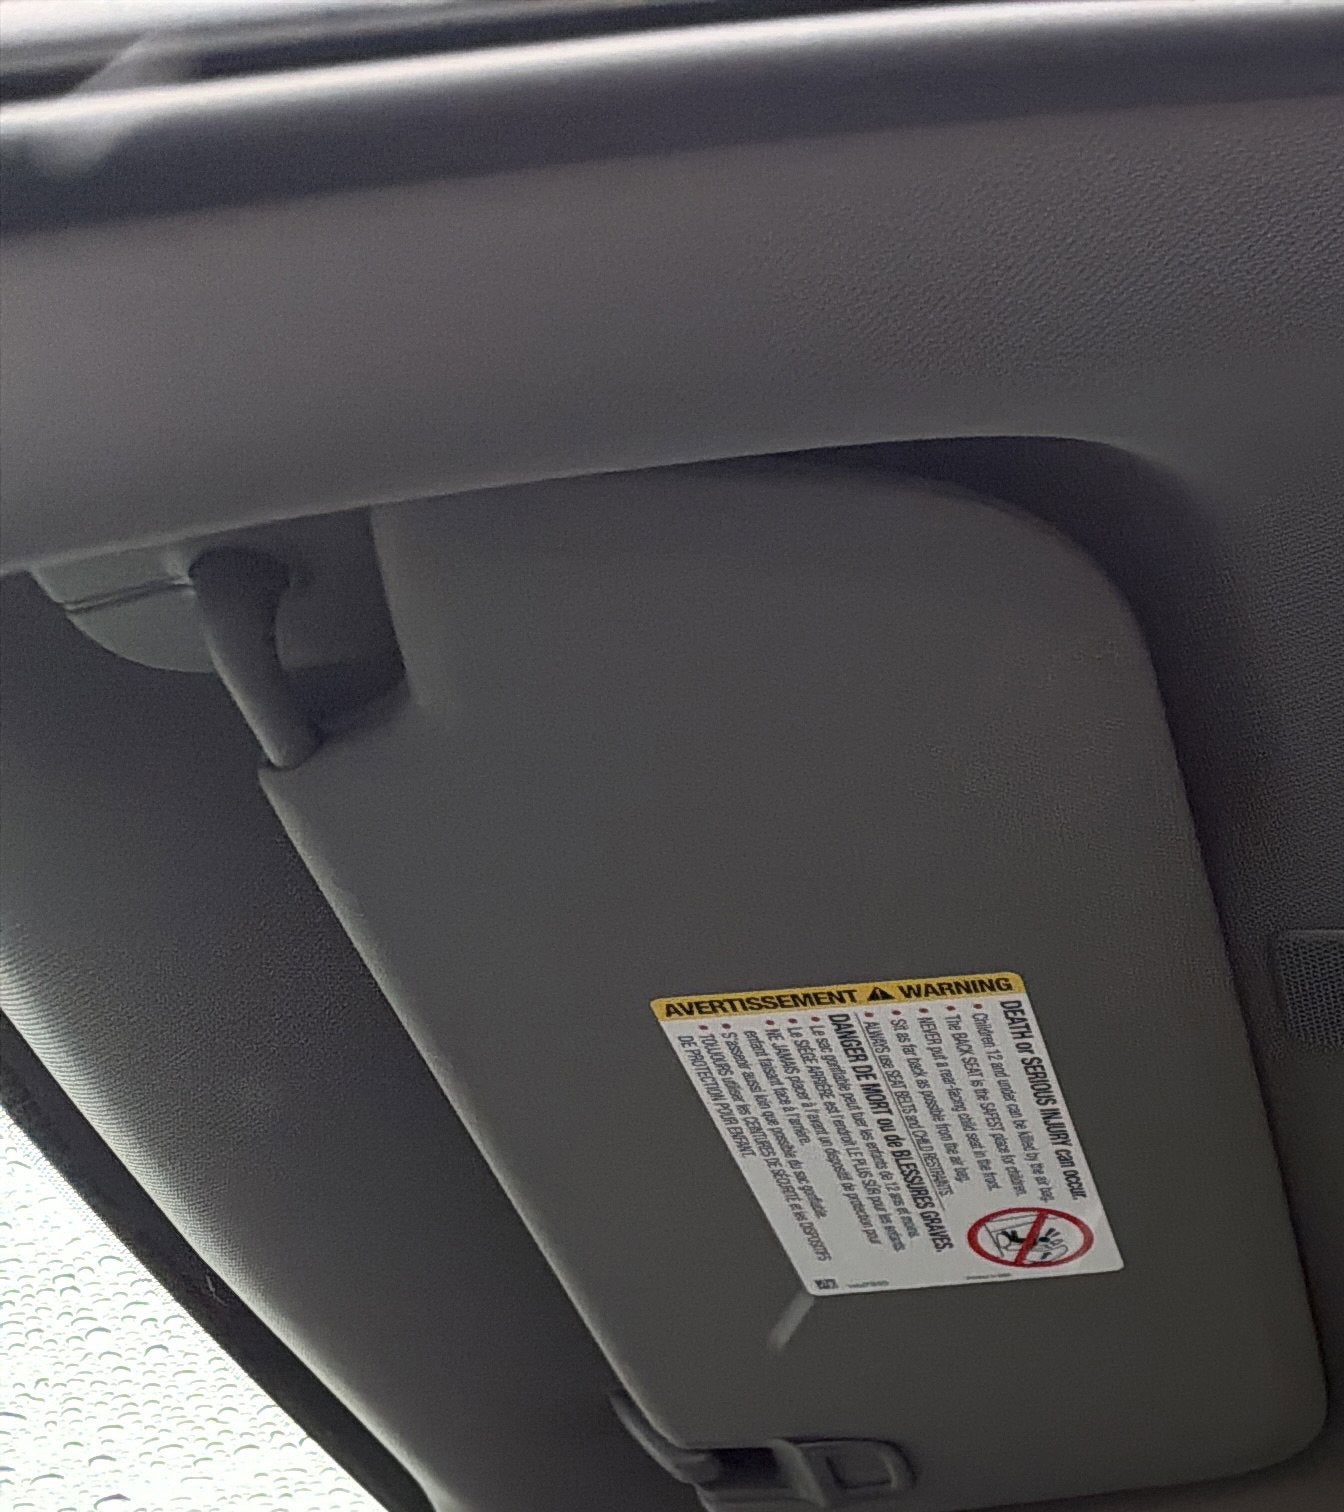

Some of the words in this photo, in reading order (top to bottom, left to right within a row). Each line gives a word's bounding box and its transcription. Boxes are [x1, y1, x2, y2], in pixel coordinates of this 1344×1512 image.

[665, 989, 857, 1017] AVERTISSEMENT
[897, 977, 1013, 999] WARNING
[890, 1018, 909, 1031] Sit
[944, 1014, 962, 1030] The
[1000, 1000, 1034, 1040] DEATH
[765, 1029, 785, 1042] NE
[787, 1027, 803, 1038] Le
[809, 1025, 825, 1036] Le
[863, 1022, 891, 1053] ALWAYS
[896, 1033, 911, 1043] as
[917, 1017, 942, 1045] NEVER
[971, 1013, 996, 1048] Children
[677, 1035, 698, 1048] DE
[815, 1038, 833, 1053] sac
[828, 1014, 868, 1063] DANGER
[951, 1032, 975, 1056] BACK
[901, 1044, 917, 1055] far
[926, 1046, 948, 1061] put
[985, 1049, 1003, 1061] 12
[1015, 1042, 1035, 1054] or
[771, 1043, 800, 1074] JAMAIS
[878, 1055, 894, 1069] use
[744, 1030, 770, 1057] enfant
[772, 1087, 791, 1105] face
[851, 1065, 877, 1081] DE
[906, 1057, 928, 1077] back
[961, 1057, 984, 1077] SEAT
[990, 1062, 1010, 1077] and
[685, 1049, 727, 1101] PROTECTION
[884, 1069, 907, 1089] SEAT
[1021, 1057, 1057, 1106] SERIOUS
[785, 1076, 811, 1100] placer
[915, 1079, 930, 1089] as
[969, 1079, 985, 1087] is
[996, 1079, 1017, 1102] under
[699, 1033, 734, 1076] TOUJOURS
[764, 1157, 783, 1168] DE
[839, 1093, 861, 1110] peut
[860, 1083, 893, 1115] MORT
[893, 1090, 918, 1114] BELTS
[973, 1088, 989, 1101] the
[714, 1103, 739, 1126] POUR
[823, 1101, 841, 1114] est
[1006, 1104, 1023, 1118] can
[761, 1111, 779, 1126] que
[905, 1115, 925, 1129] and
[957, 1113, 978, 1132] child
[979, 1102, 1005, 1132] SAFEST
[1012, 1119, 1027, 1130] be
[877, 1118, 896, 1132] ou
[935, 1123, 953, 1141] from
[1039, 1108, 1073, 1146] INJURY
[817, 1137, 833, 1147] un
[859, 1129, 874, 1141] les
[883, 1134, 906, 1148] de
[912, 1130, 934, 1152] CHILD
[845, 1147, 864, 1158] LE
[943, 1142, 959, 1155] the
[787, 1159, 804, 1169] du
[1000, 1154, 1016, 1165] for
[1024, 1152, 1040, 1161] by
[1054, 1149, 1075, 1168] can
[851, 1158, 873, 1179] PLUS
[878, 1171, 894, 1180] de
[1030, 1163, 1044, 1175] the
[793, 1170, 810, 1184] sac
[890, 1149, 935, 1209] BLESSURES
[840, 1182, 856, 1192] de
[884, 1182, 901, 1192] 12
[1062, 1170, 1087, 1200] occur.
[919, 1211, 954, 1252] GRAVES.
